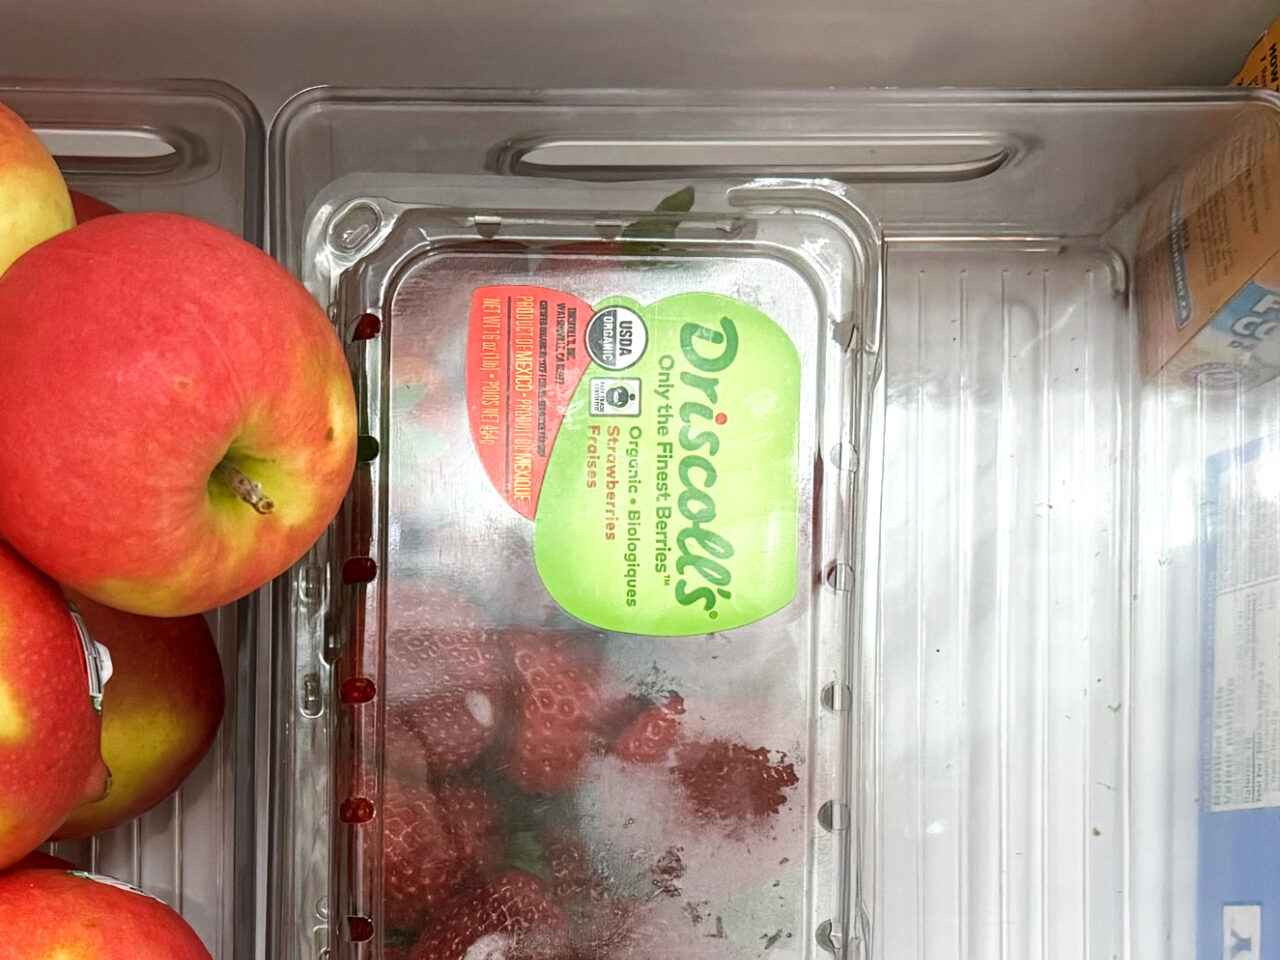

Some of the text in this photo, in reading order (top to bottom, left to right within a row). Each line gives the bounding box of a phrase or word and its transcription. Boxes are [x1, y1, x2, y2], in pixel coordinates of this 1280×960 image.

[483, 298, 501, 313] NET
[483, 316, 501, 328] WT
[482, 341, 496, 351] oz
[483, 330, 500, 340] 16
[601, 316, 615, 361] ORGANIC
[618, 320, 633, 357] USDA
[482, 381, 500, 405] POIDS
[654, 354, 675, 401] Only
[481, 408, 499, 424] NET
[514, 296, 533, 501] PRODUCT OF MEXICO PRODUIT DU MEXIQUE
[657, 403, 674, 437] the
[586, 425, 601, 489] Fraises
[656, 441, 673, 502] Finest
[675, 316, 739, 612] Driscoll's
[605, 425, 620, 541] Strawberries
[623, 425, 642, 608] Organic Biologiques
